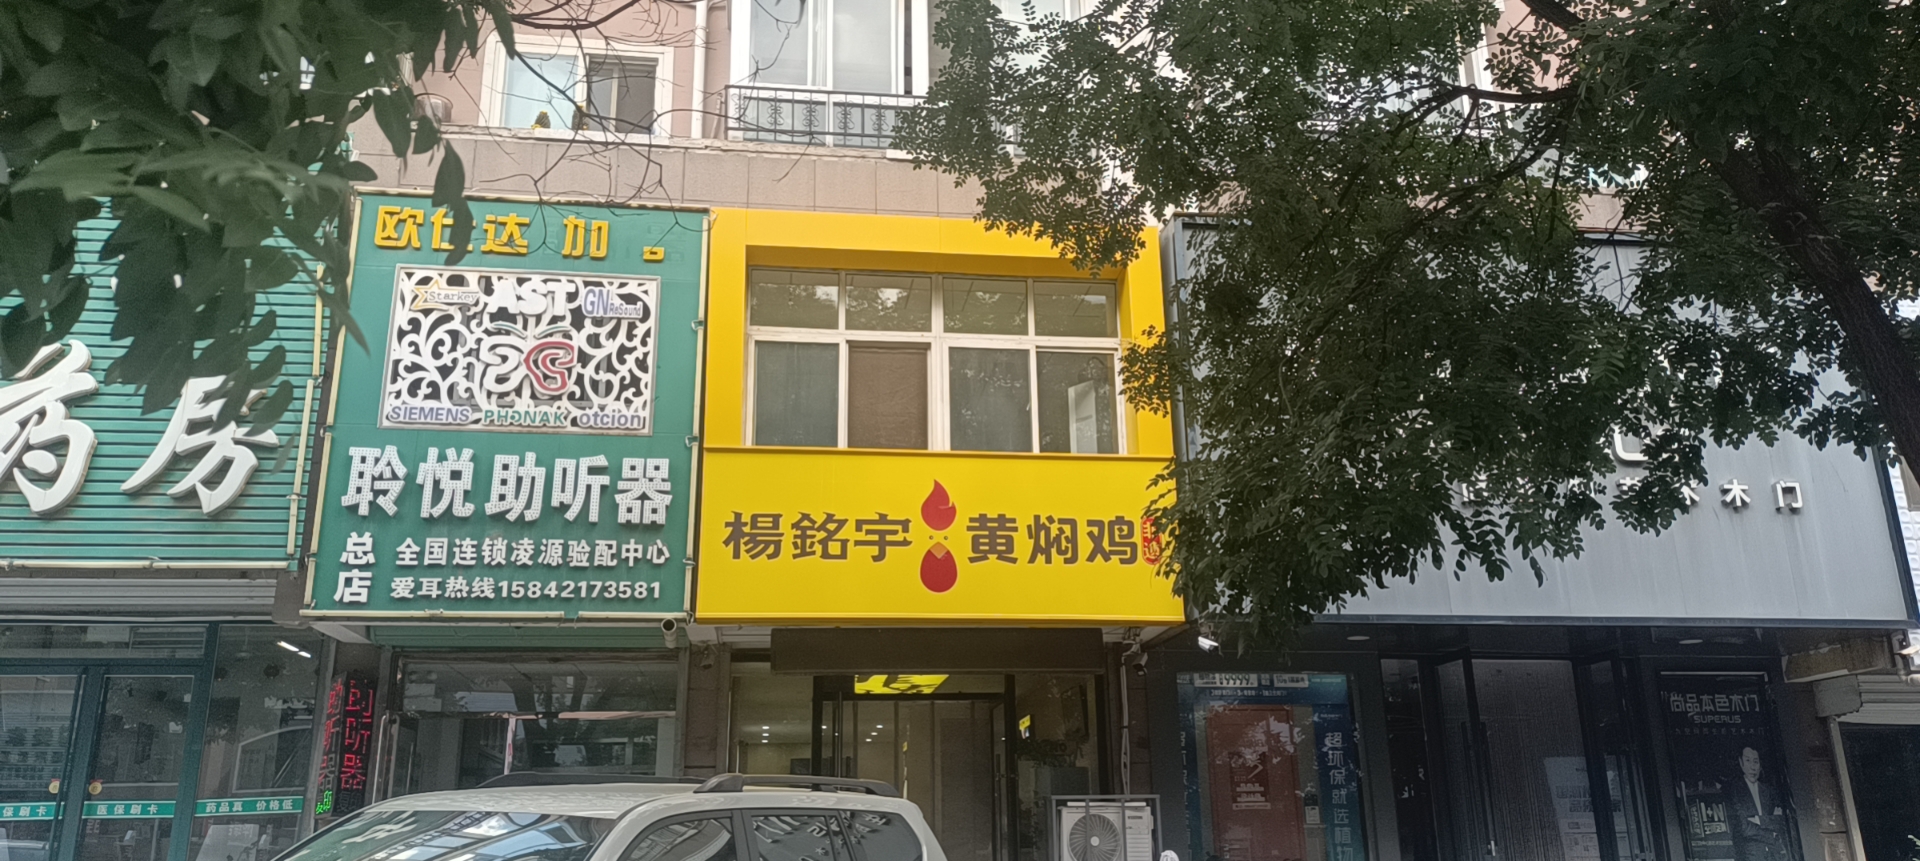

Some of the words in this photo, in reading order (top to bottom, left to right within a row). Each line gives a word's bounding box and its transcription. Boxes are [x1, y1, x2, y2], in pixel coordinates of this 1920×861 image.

[427, 290, 480, 304] Starkey
[487, 279, 577, 316] AST
[583, 287, 611, 317] GN
[390, 405, 471, 423] SIEMENS
[578, 410, 642, 428] otcion
[340, 444, 673, 526] 聆悦助听器
[721, 510, 914, 563] 楊銘宇
[965, 513, 1139, 566] 黄焖鸡
[394, 536, 671, 568] 全国连锁凌源验配中心
[333, 531, 376, 604] 总店
[389, 575, 662, 600] 爱耳热线15842173581
[1669, 693, 1760, 713] 尚品本色木门
[1693, 714, 1742, 724] SUPERUS
[96, 803, 160, 816] 医保刷卡
[204, 801, 244, 813] 药品真
[255, 799, 294, 812] 价格低
